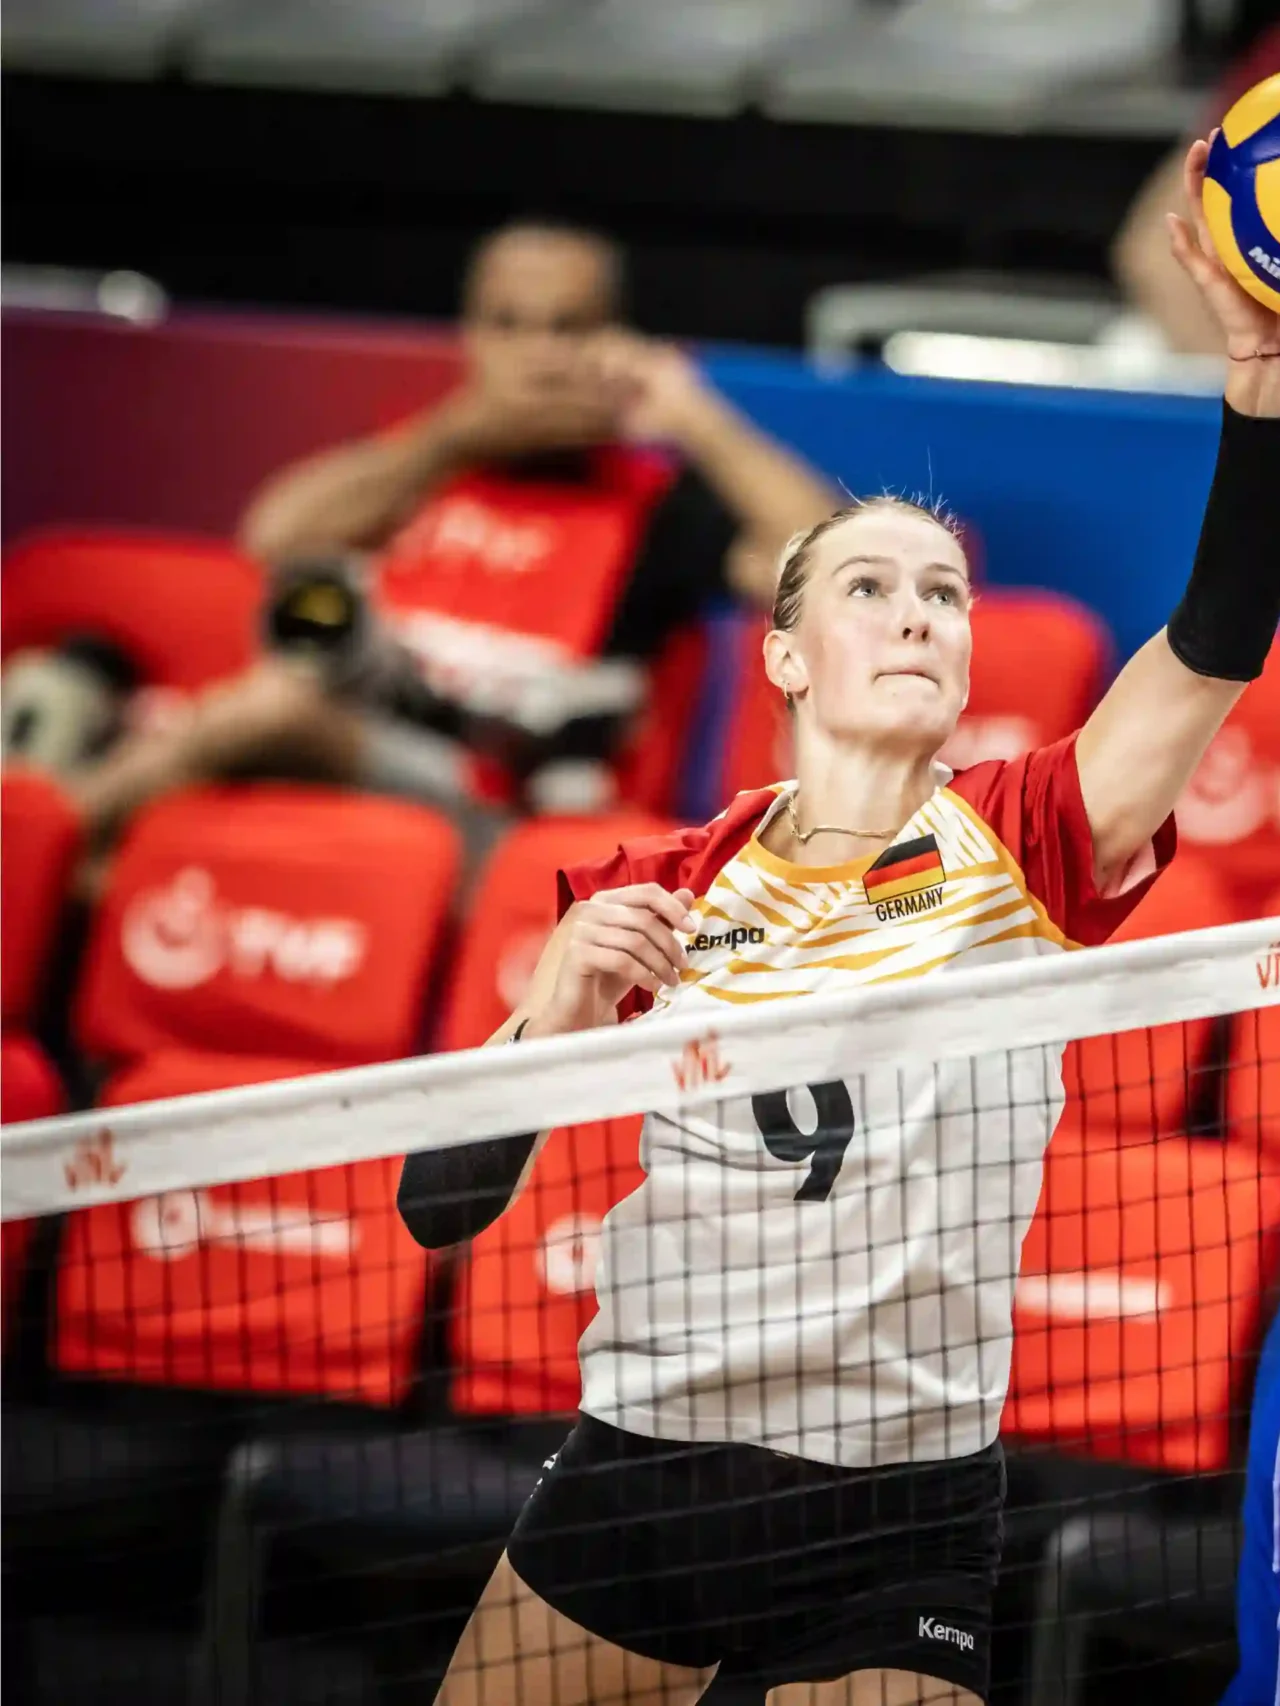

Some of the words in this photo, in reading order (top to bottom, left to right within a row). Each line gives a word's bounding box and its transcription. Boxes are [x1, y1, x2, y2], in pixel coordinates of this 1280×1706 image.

[874, 887, 945, 922] GERMANY
[751, 1078, 855, 1202] 9
[918, 1616, 975, 1651] Kempa
